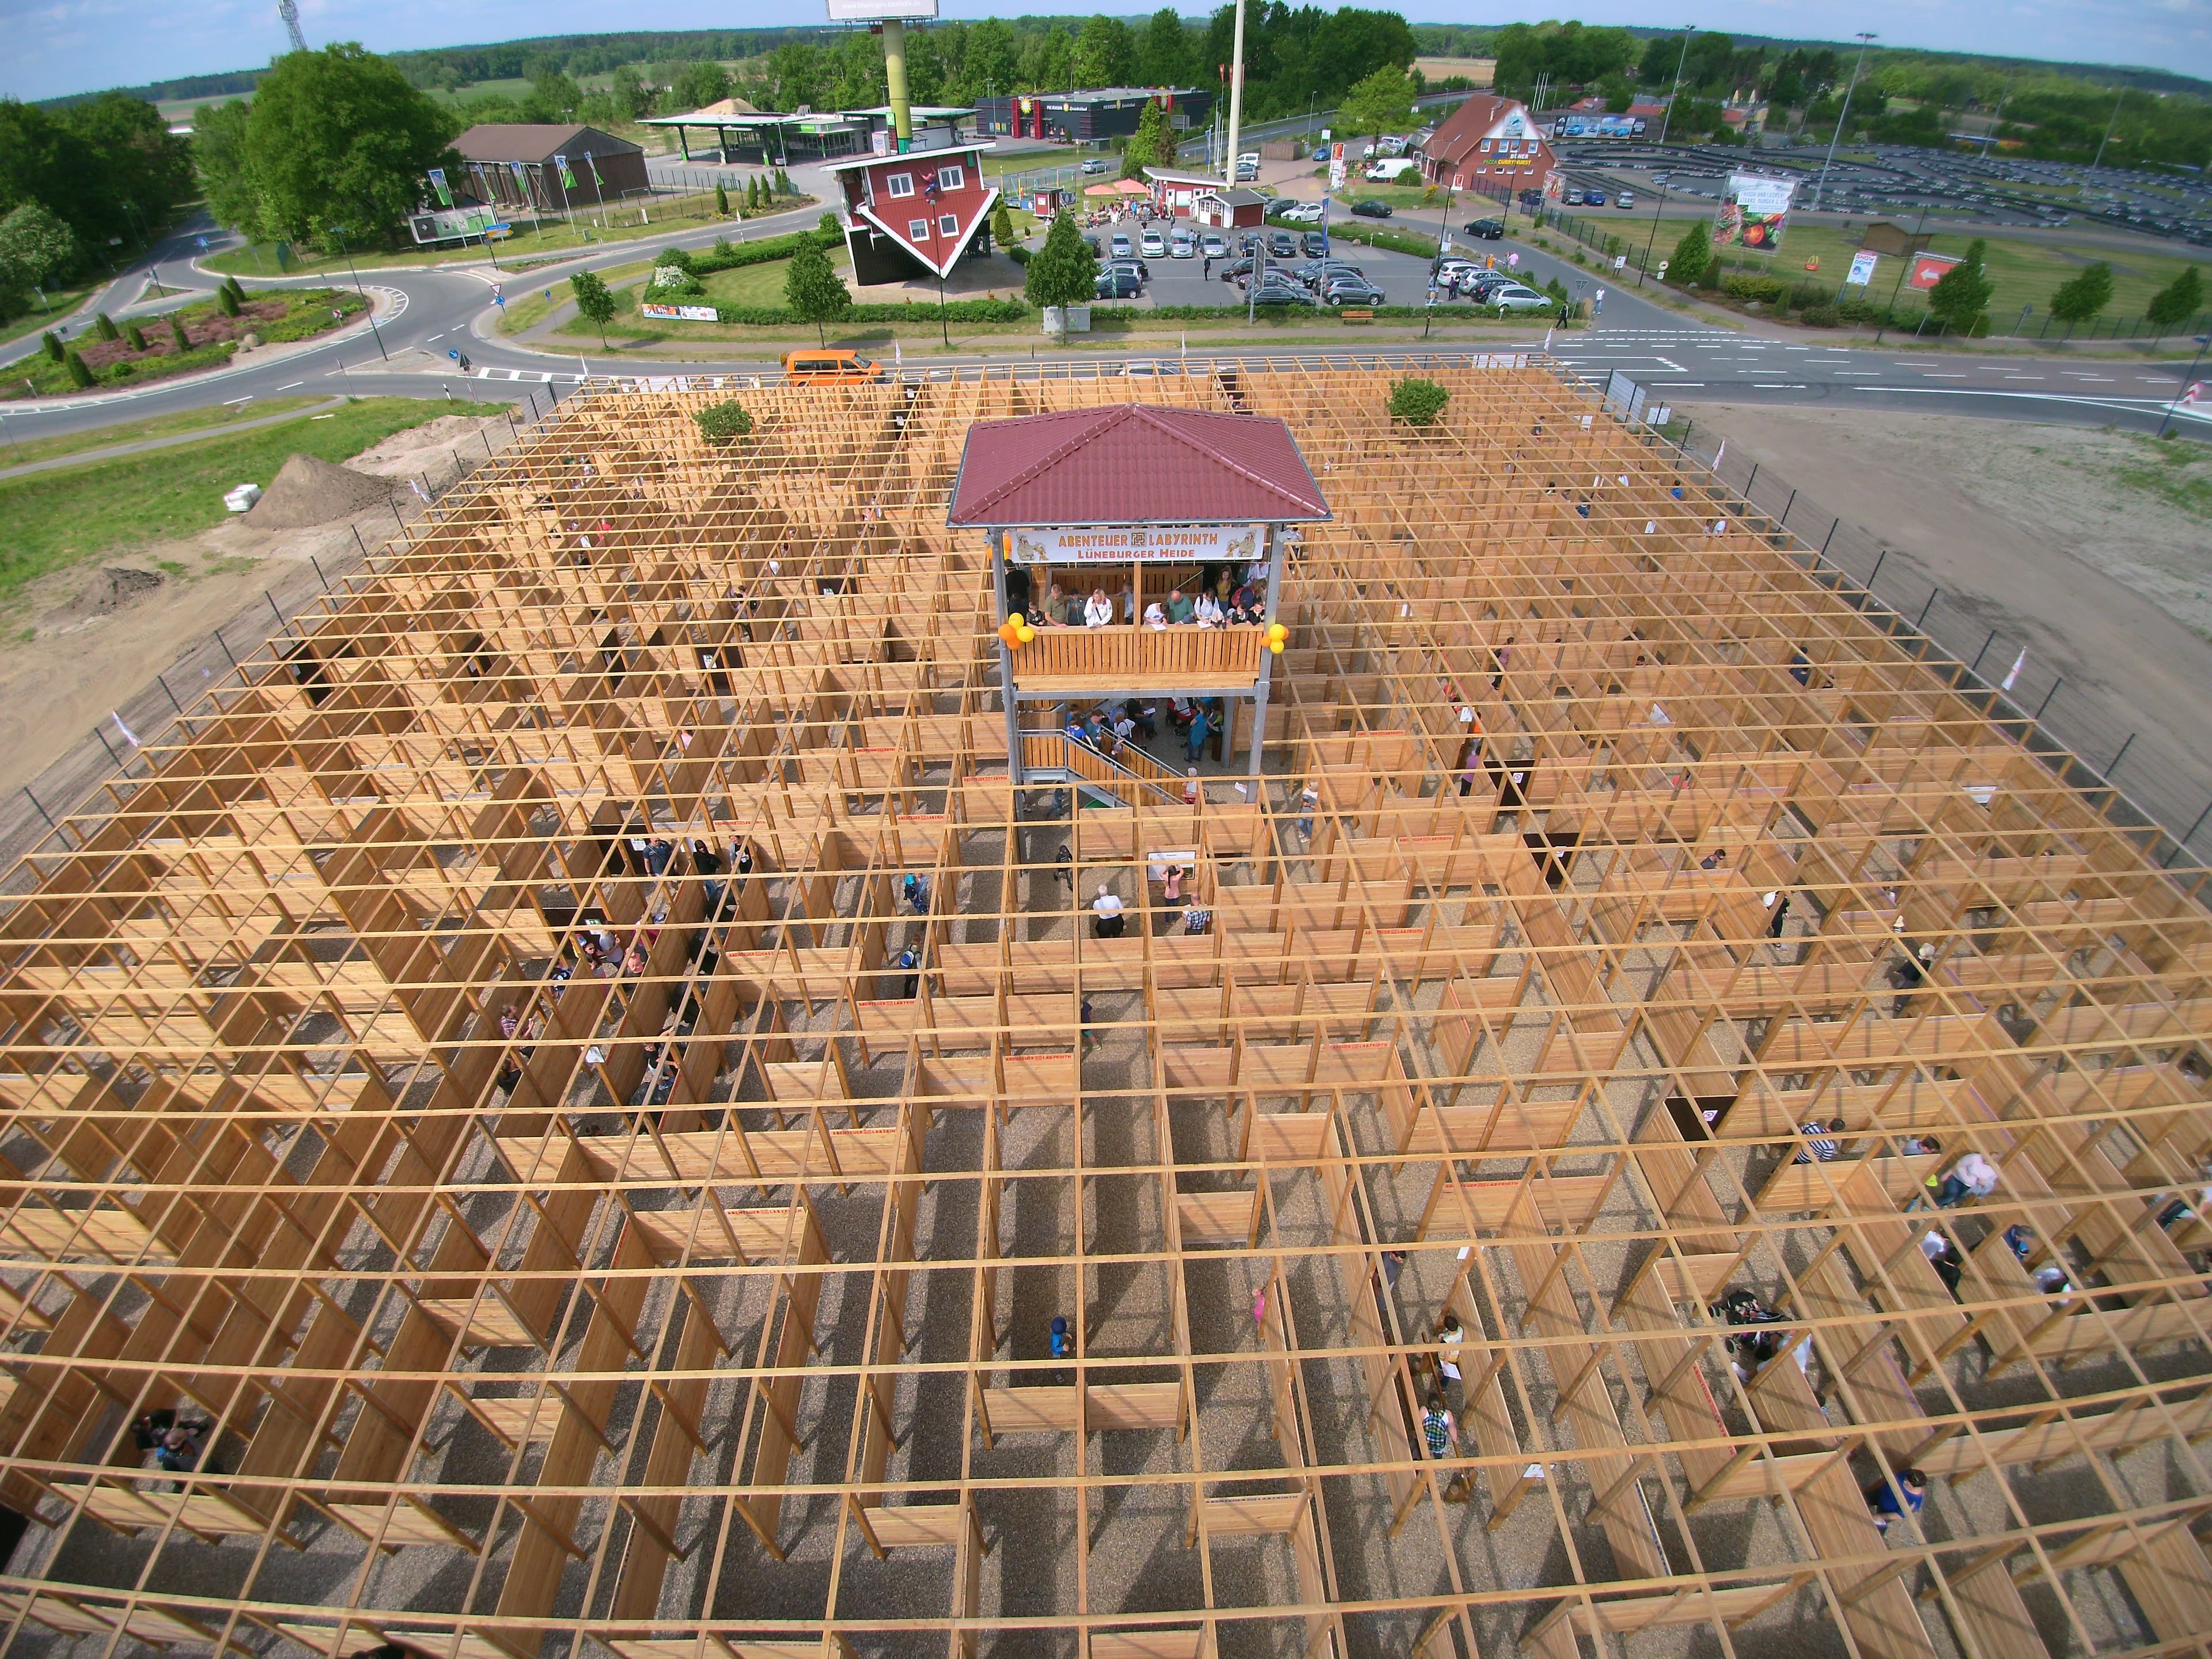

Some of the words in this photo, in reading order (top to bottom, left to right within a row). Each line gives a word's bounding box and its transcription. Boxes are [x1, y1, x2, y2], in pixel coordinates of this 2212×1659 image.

[1059, 535, 1127, 547] ABENTEUER
[1149, 533, 1218, 545] LABYRINTH
[1078, 548, 1154, 559] LÜNEBURGER
[1160, 549, 1195, 558] HEIDE
